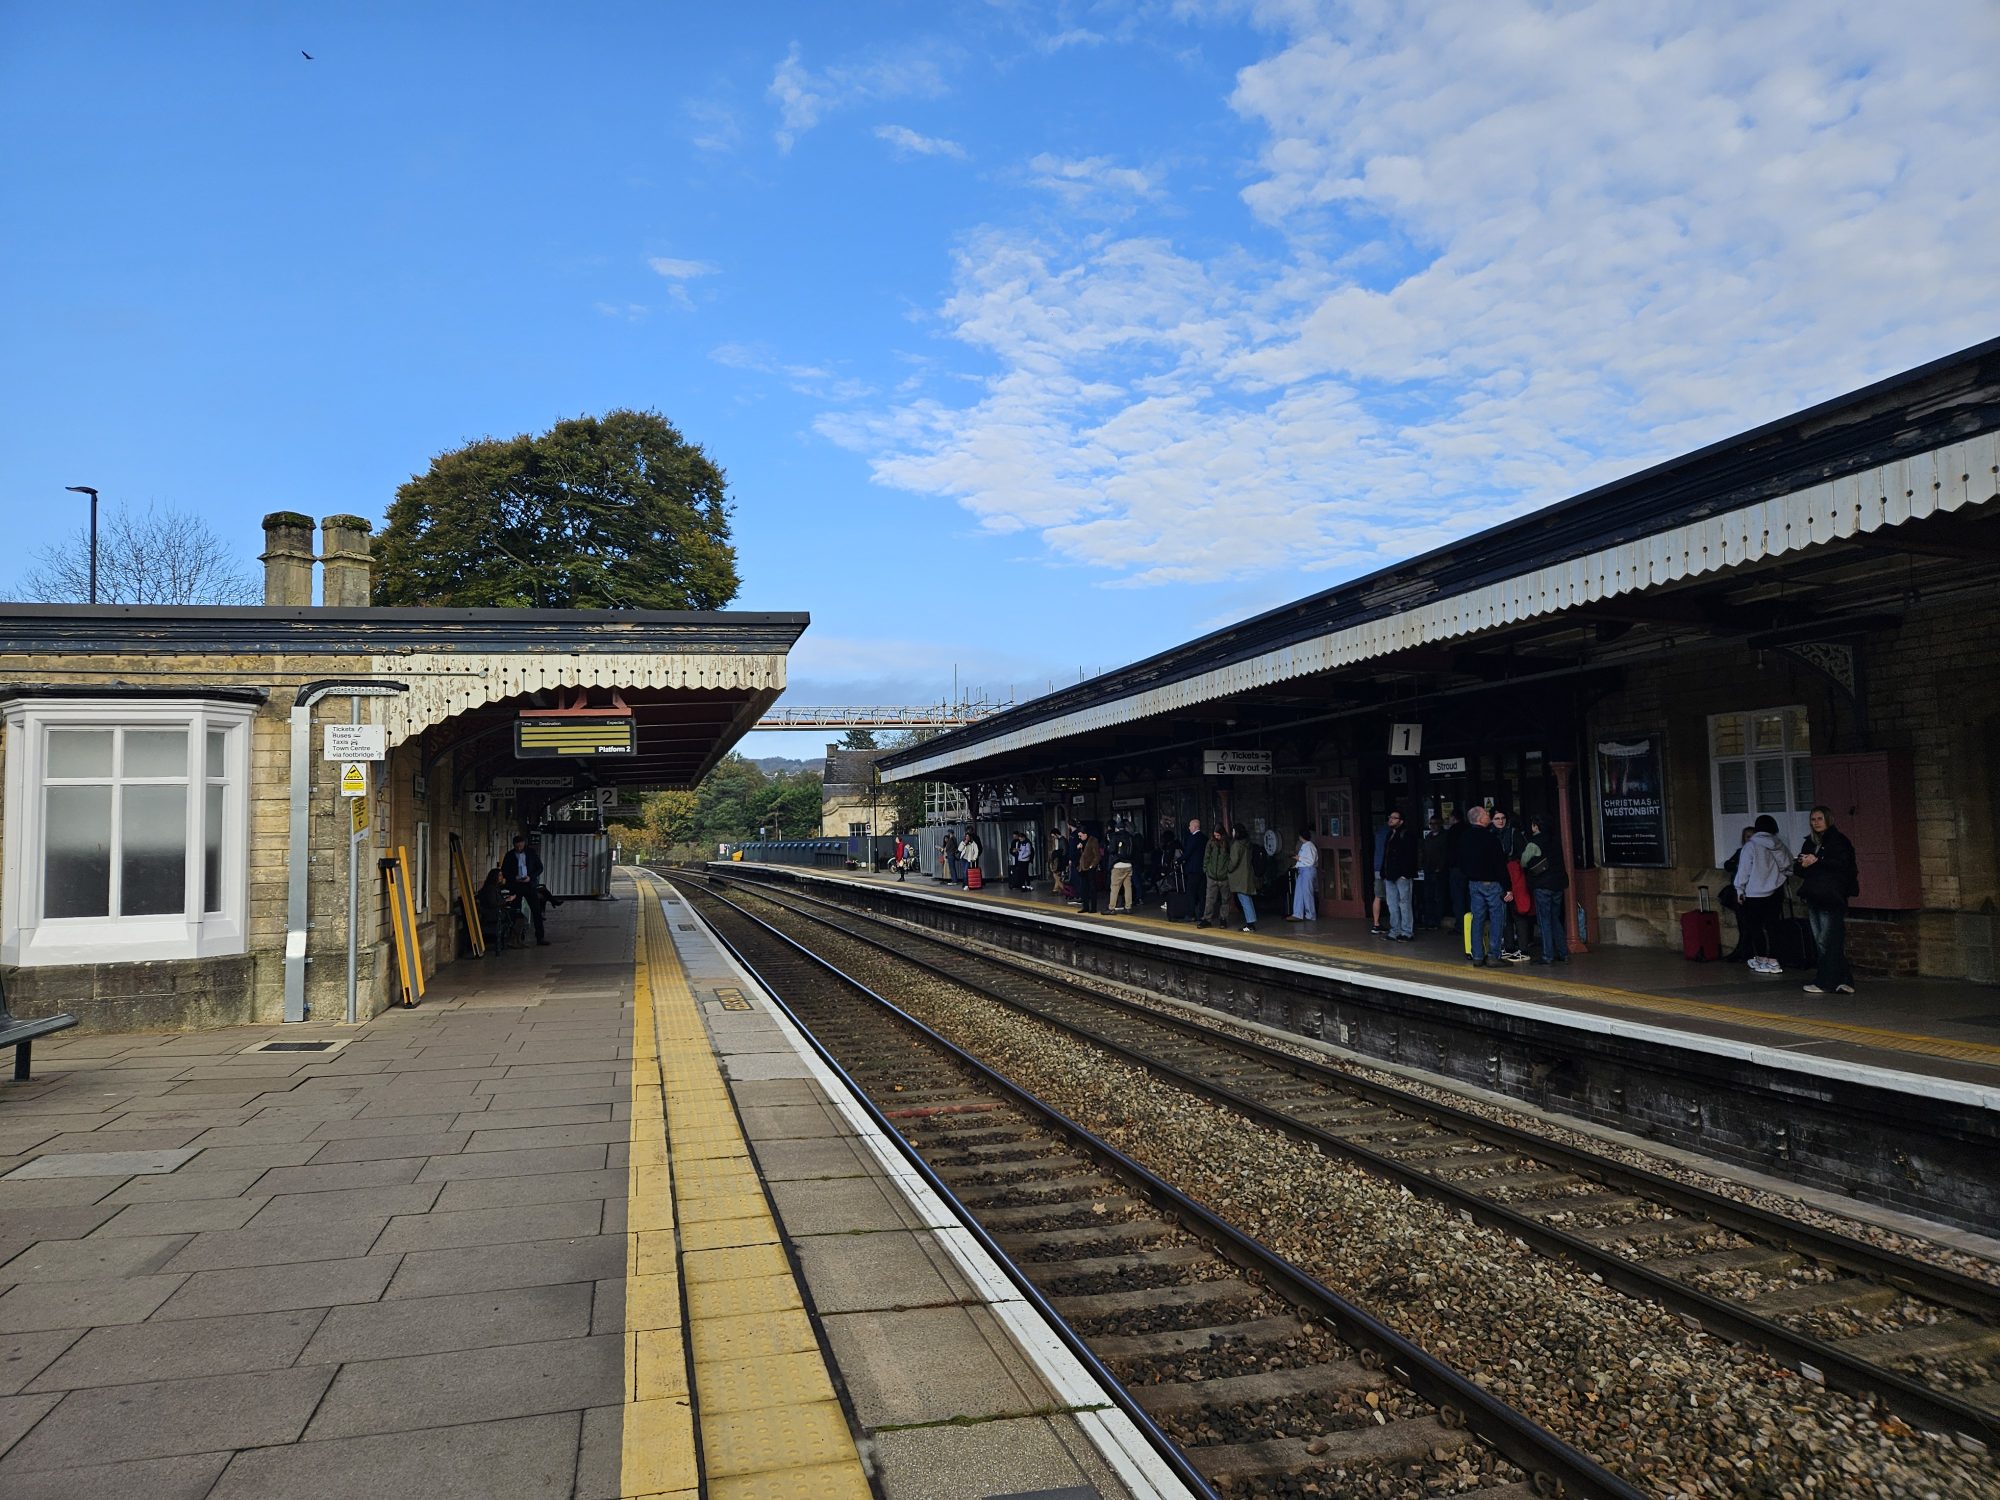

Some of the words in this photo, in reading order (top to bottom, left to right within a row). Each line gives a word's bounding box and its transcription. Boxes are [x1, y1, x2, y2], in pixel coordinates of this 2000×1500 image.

[1403, 728, 1410, 751] 1
[598, 745, 625, 753] Platform
[626, 745, 631, 753] 2
[1231, 751, 1260, 760] Tickets
[1228, 763, 1246, 773] Way
[1246, 763, 1260, 772] out
[1436, 762, 1458, 771] Stroud
[513, 777, 541, 786] Waiting
[601, 789, 613, 805] 2
[1604, 798, 1651, 807] CHRISTMAS
[1605, 806, 1660, 816] WESTONBIRT
